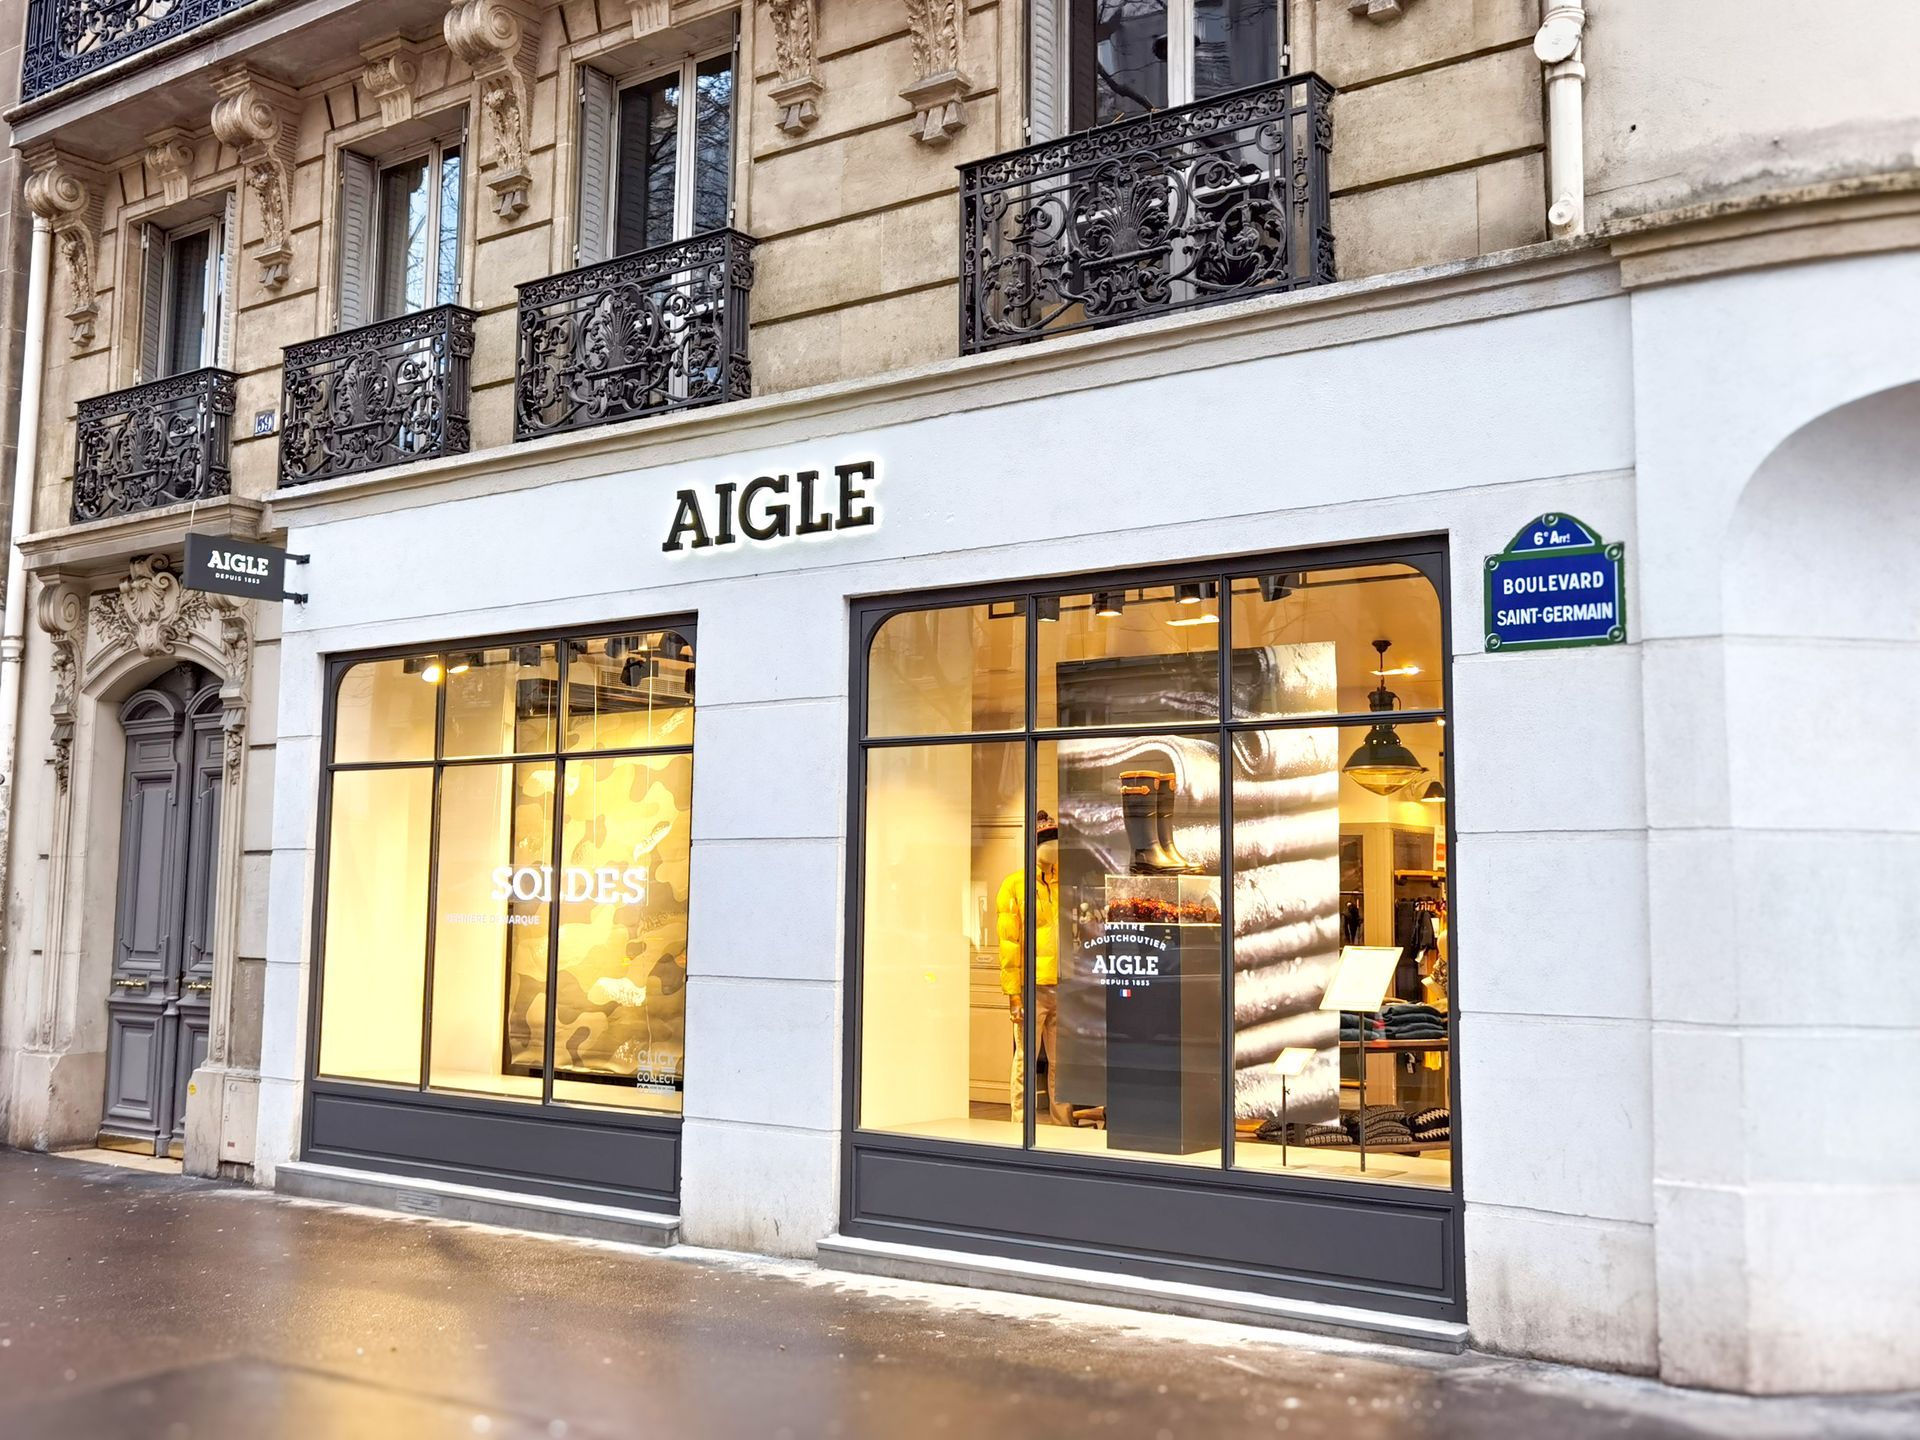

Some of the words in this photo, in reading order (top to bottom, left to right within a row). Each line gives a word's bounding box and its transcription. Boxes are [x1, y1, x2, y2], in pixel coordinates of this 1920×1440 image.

[662, 460, 875, 552] AIGLE
[207, 550, 269, 576] AIGLE
[215, 572, 242, 582] DEPUIS
[1503, 571, 1604, 595] BOULEVARD
[1497, 602, 1613, 626] SAINT-GERMAIN
[1084, 934, 1167, 951] CAOUTCHOUTIER
[1092, 955, 1159, 976] AIGLE
[637, 1072, 676, 1085] COLLECT
